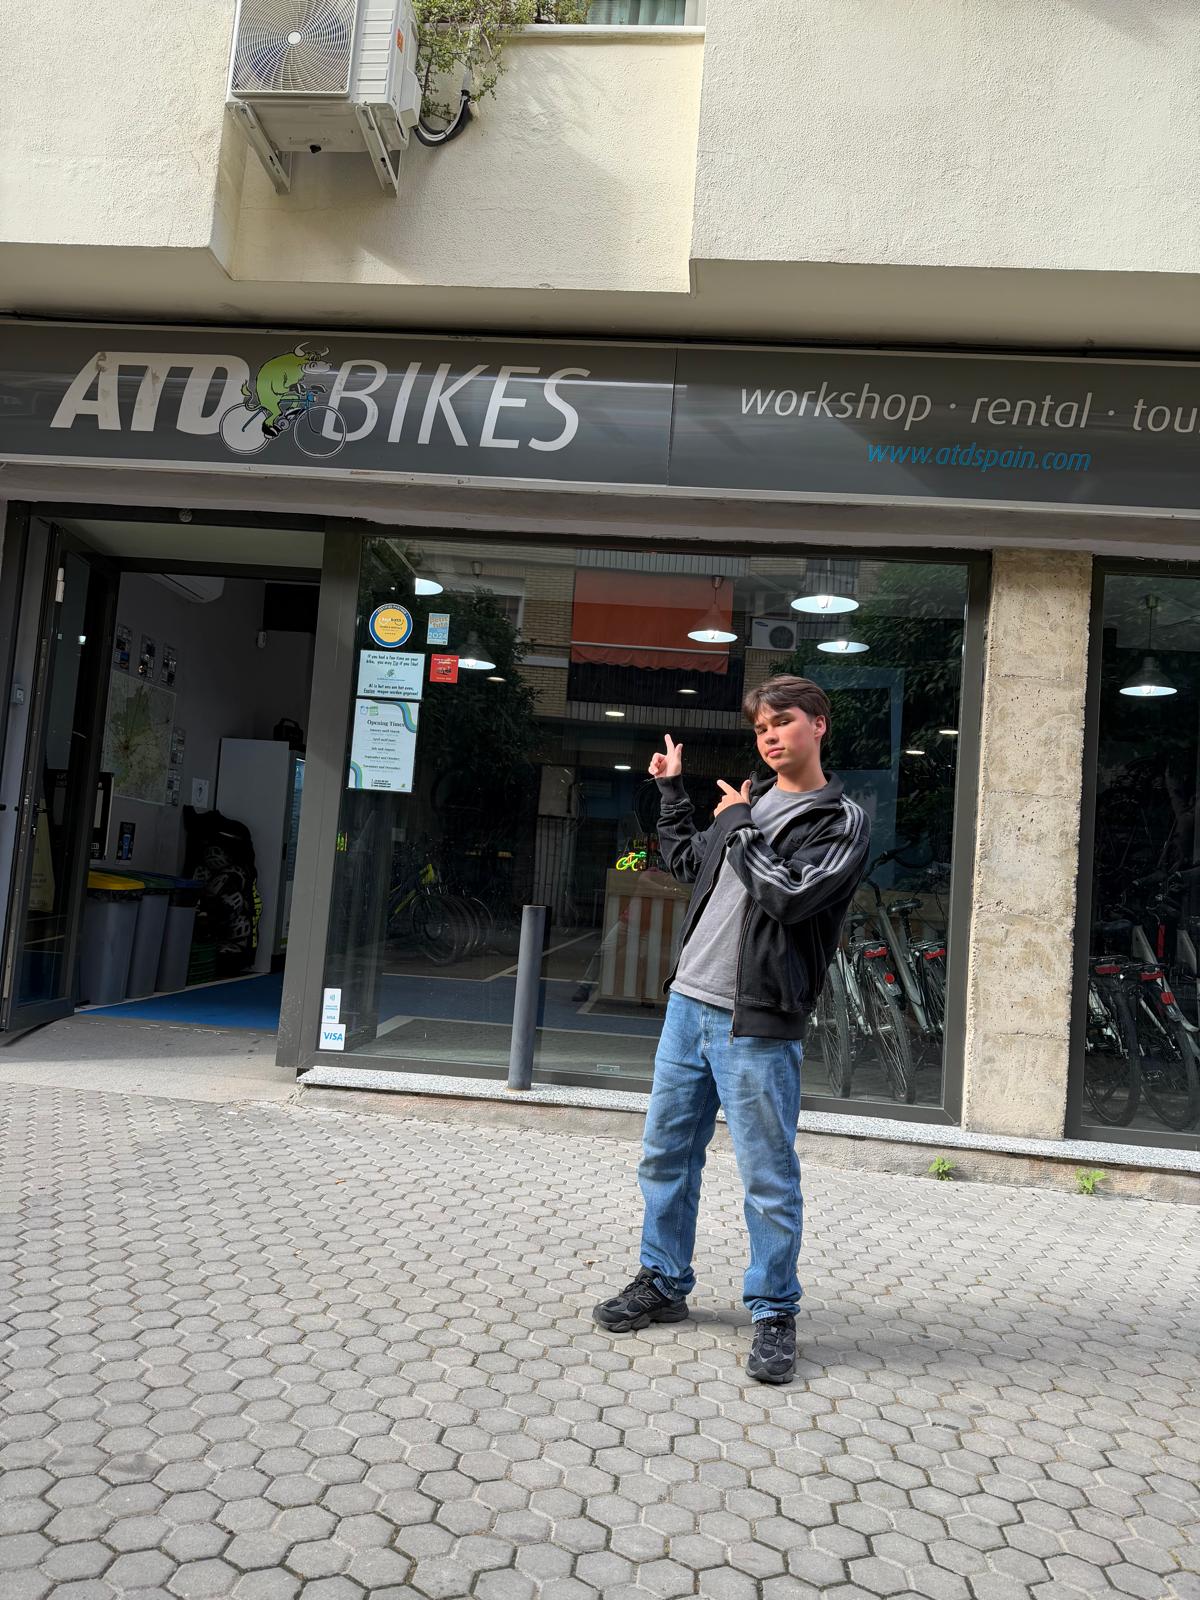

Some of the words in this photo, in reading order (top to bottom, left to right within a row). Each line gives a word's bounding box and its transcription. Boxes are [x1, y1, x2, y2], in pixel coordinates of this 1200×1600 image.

[321, 359, 590, 452] BIKES
[741, 382, 932, 431] workshop
[971, 393, 1093, 428] rental
[1133, 399, 1200, 433] tou
[867, 442, 1092, 473] www.atdspain.com
[366, 719, 389, 727] Opening
[323, 1032, 343, 1041] VISA
